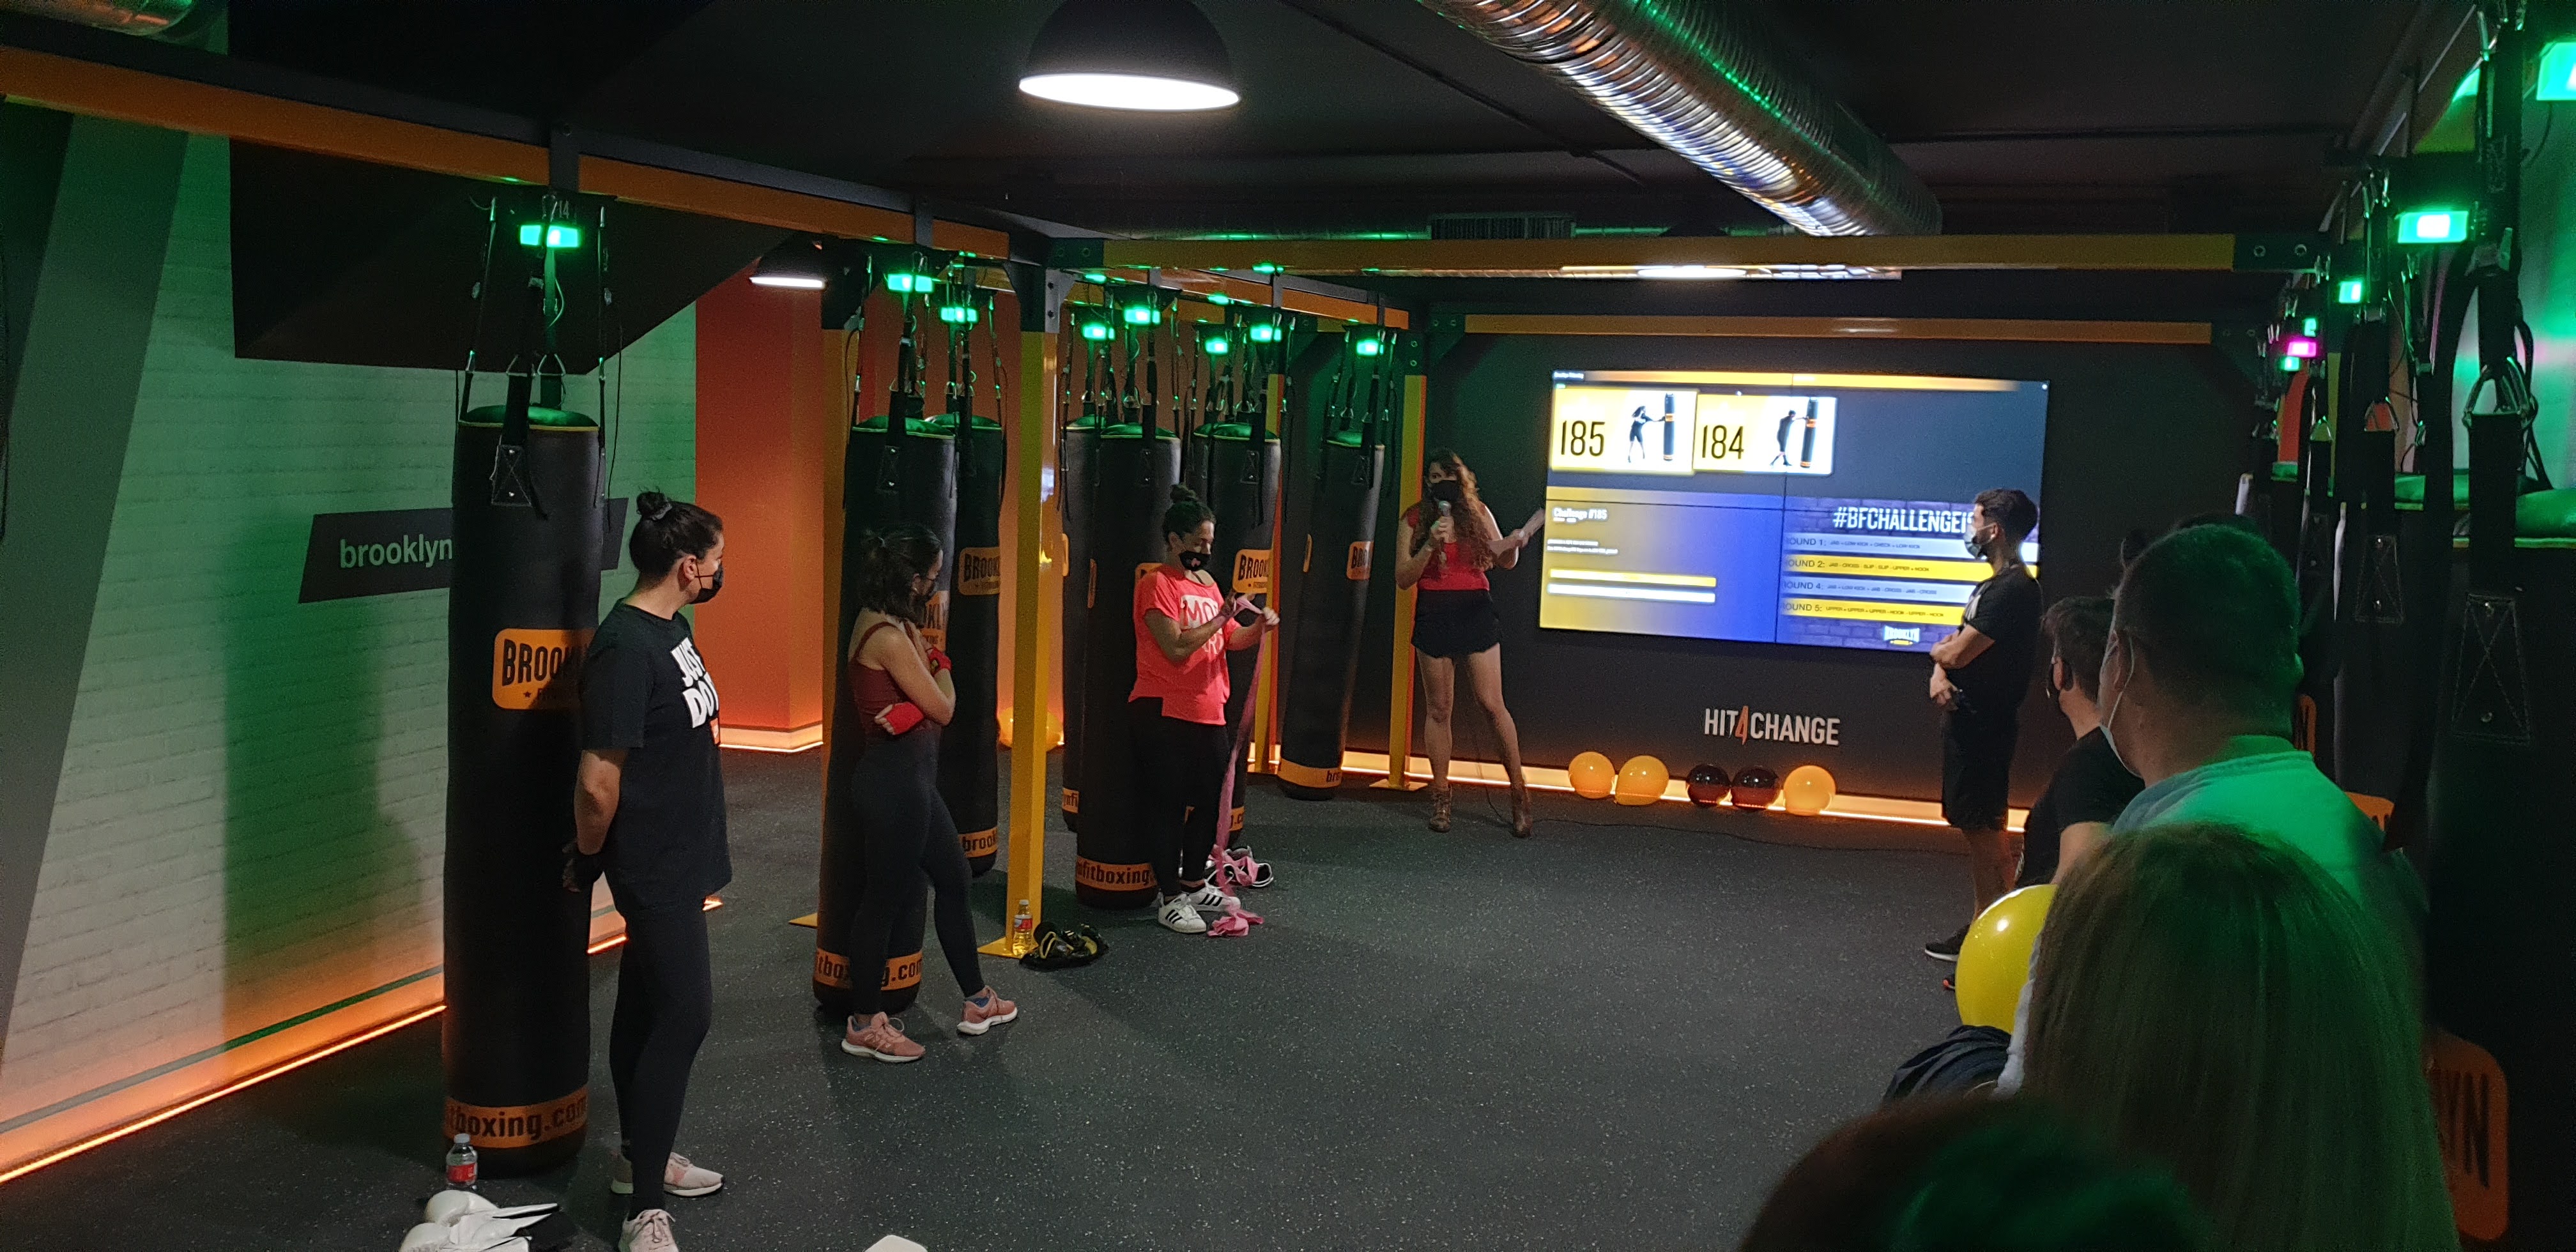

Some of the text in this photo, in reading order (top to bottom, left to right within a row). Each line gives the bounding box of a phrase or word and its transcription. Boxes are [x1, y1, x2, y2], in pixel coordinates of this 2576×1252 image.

[1561, 420, 1606, 457] 185
[1702, 425, 1744, 459] 184
[340, 534, 452, 568] brooklyn
